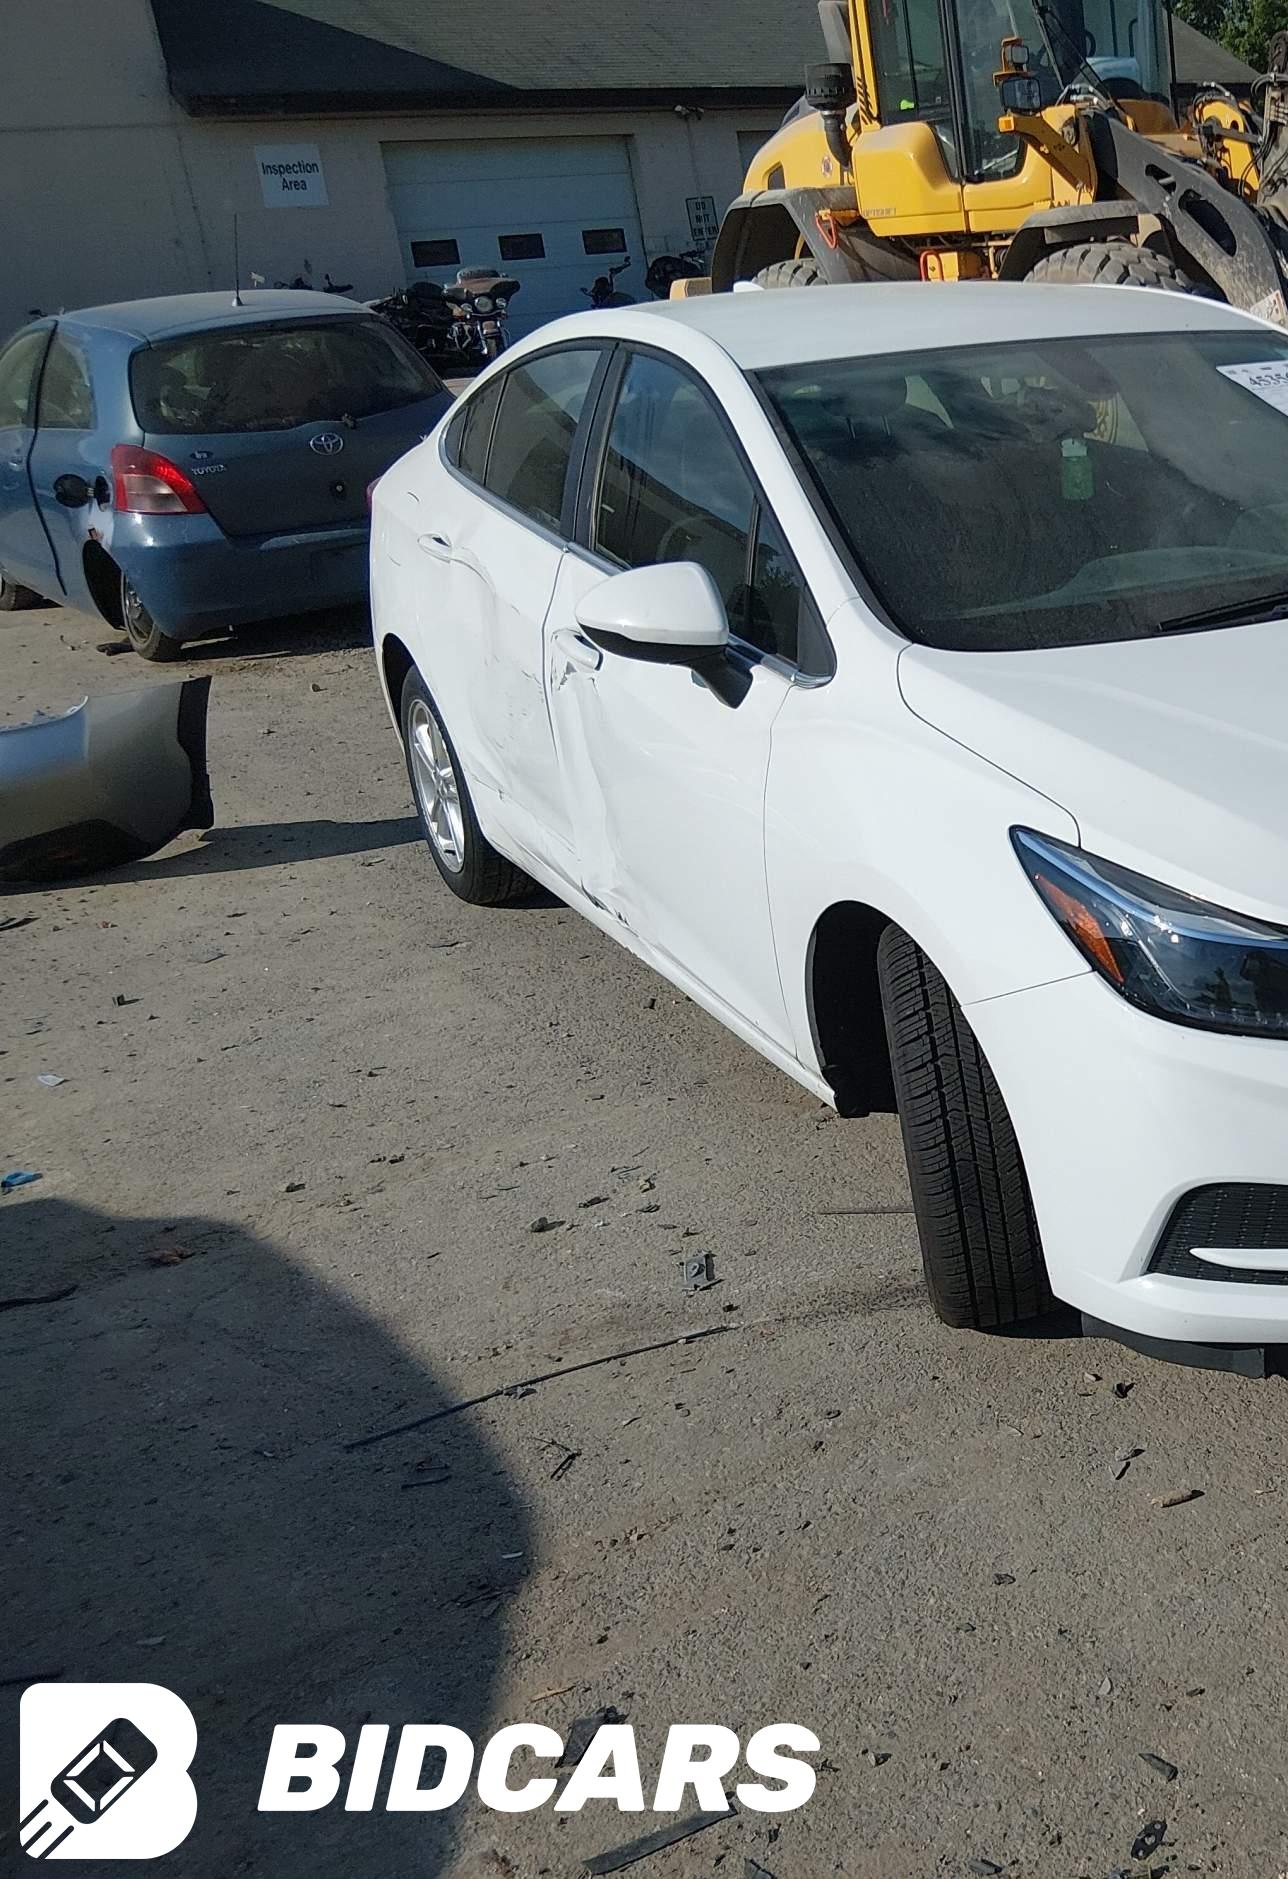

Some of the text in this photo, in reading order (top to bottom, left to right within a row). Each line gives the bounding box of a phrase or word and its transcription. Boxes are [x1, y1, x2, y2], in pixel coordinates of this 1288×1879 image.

[261, 160, 320, 176] Inspection
[281, 178, 308, 191] Area
[192, 464, 227, 475] TOYOTA
